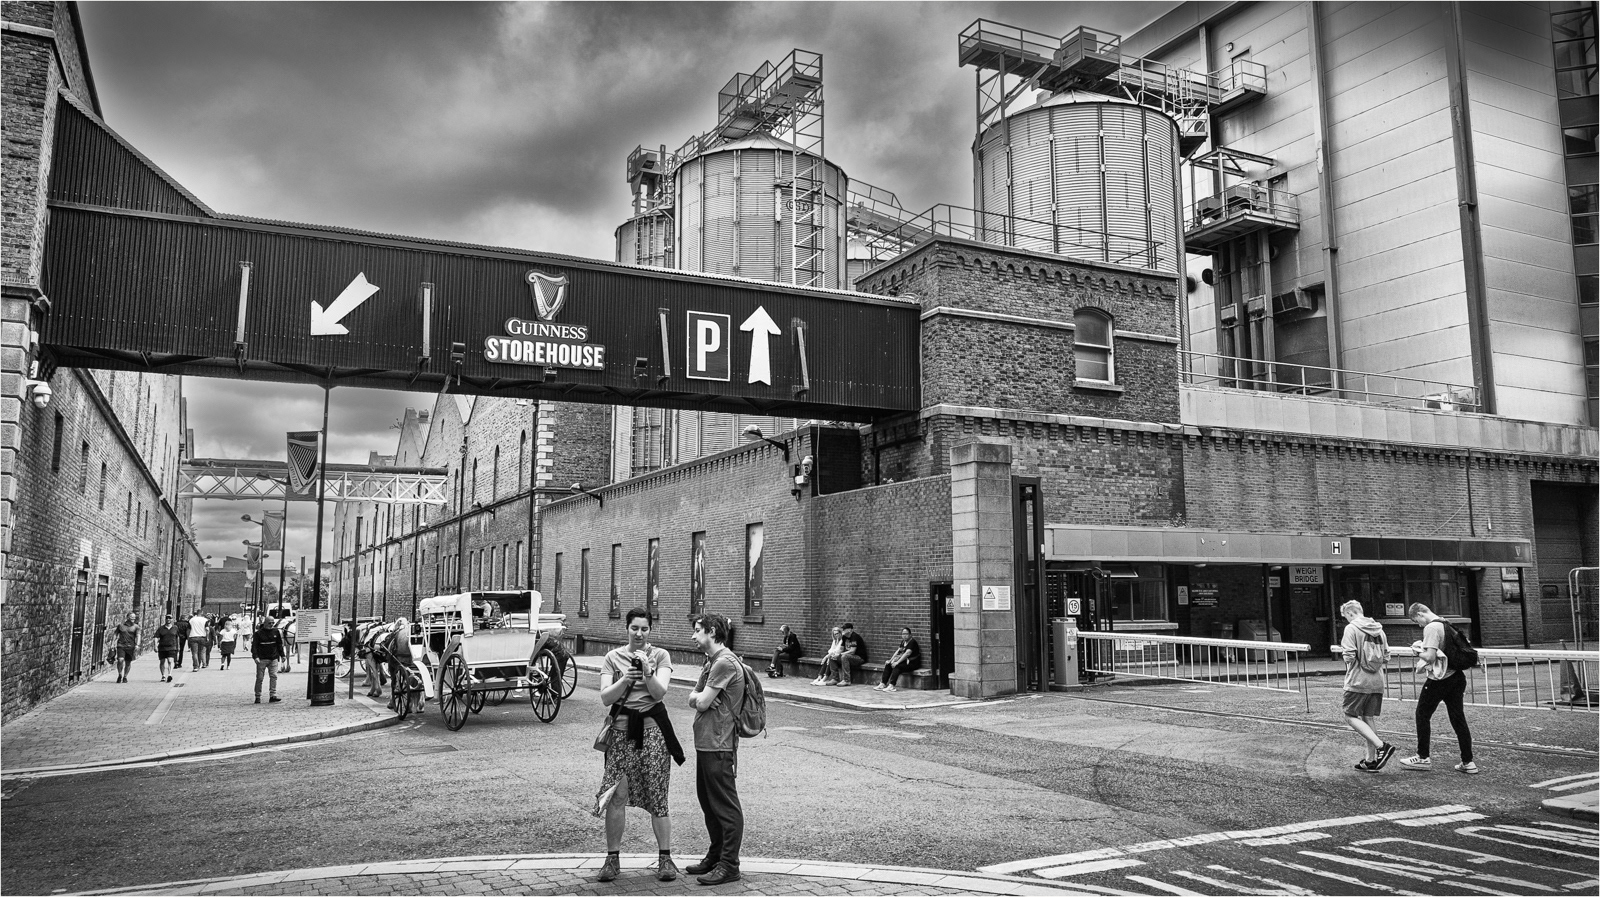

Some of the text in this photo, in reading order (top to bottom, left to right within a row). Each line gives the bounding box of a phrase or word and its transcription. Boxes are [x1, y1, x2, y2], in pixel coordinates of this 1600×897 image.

[508, 319, 587, 340] GUINNESS
[697, 319, 720, 372] P
[487, 337, 604, 367] STOREHOUSE
[1332, 542, 1340, 554] H
[1295, 567, 1317, 575] WEIGH
[1294, 575, 1319, 583] BRIDGE
[1070, 602, 1078, 610] 15
